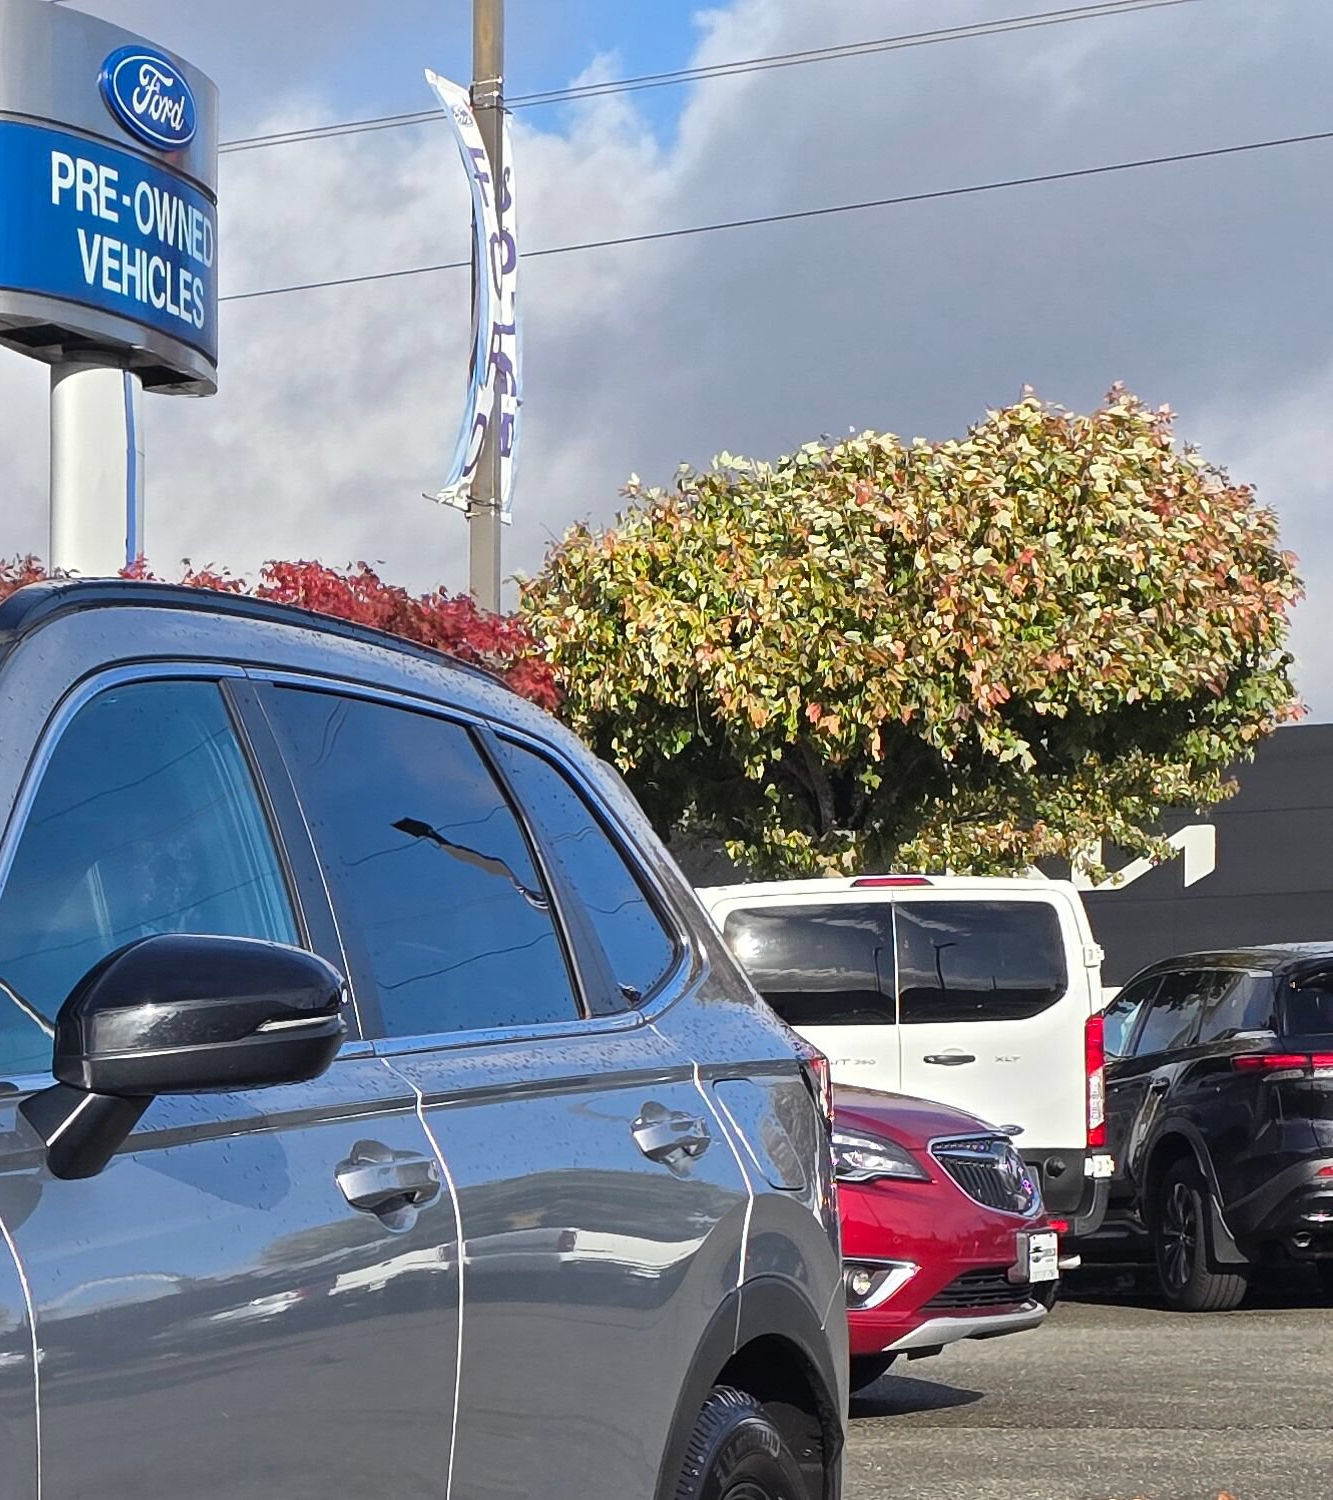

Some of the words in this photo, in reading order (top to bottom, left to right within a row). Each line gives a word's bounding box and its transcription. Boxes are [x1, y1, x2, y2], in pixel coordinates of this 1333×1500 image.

[132, 63, 186, 131] Ford
[50, 151, 215, 268] PRE-OWNED
[77, 228, 205, 330] VEHICLES
[993, 1055, 1022, 1063] XLT
